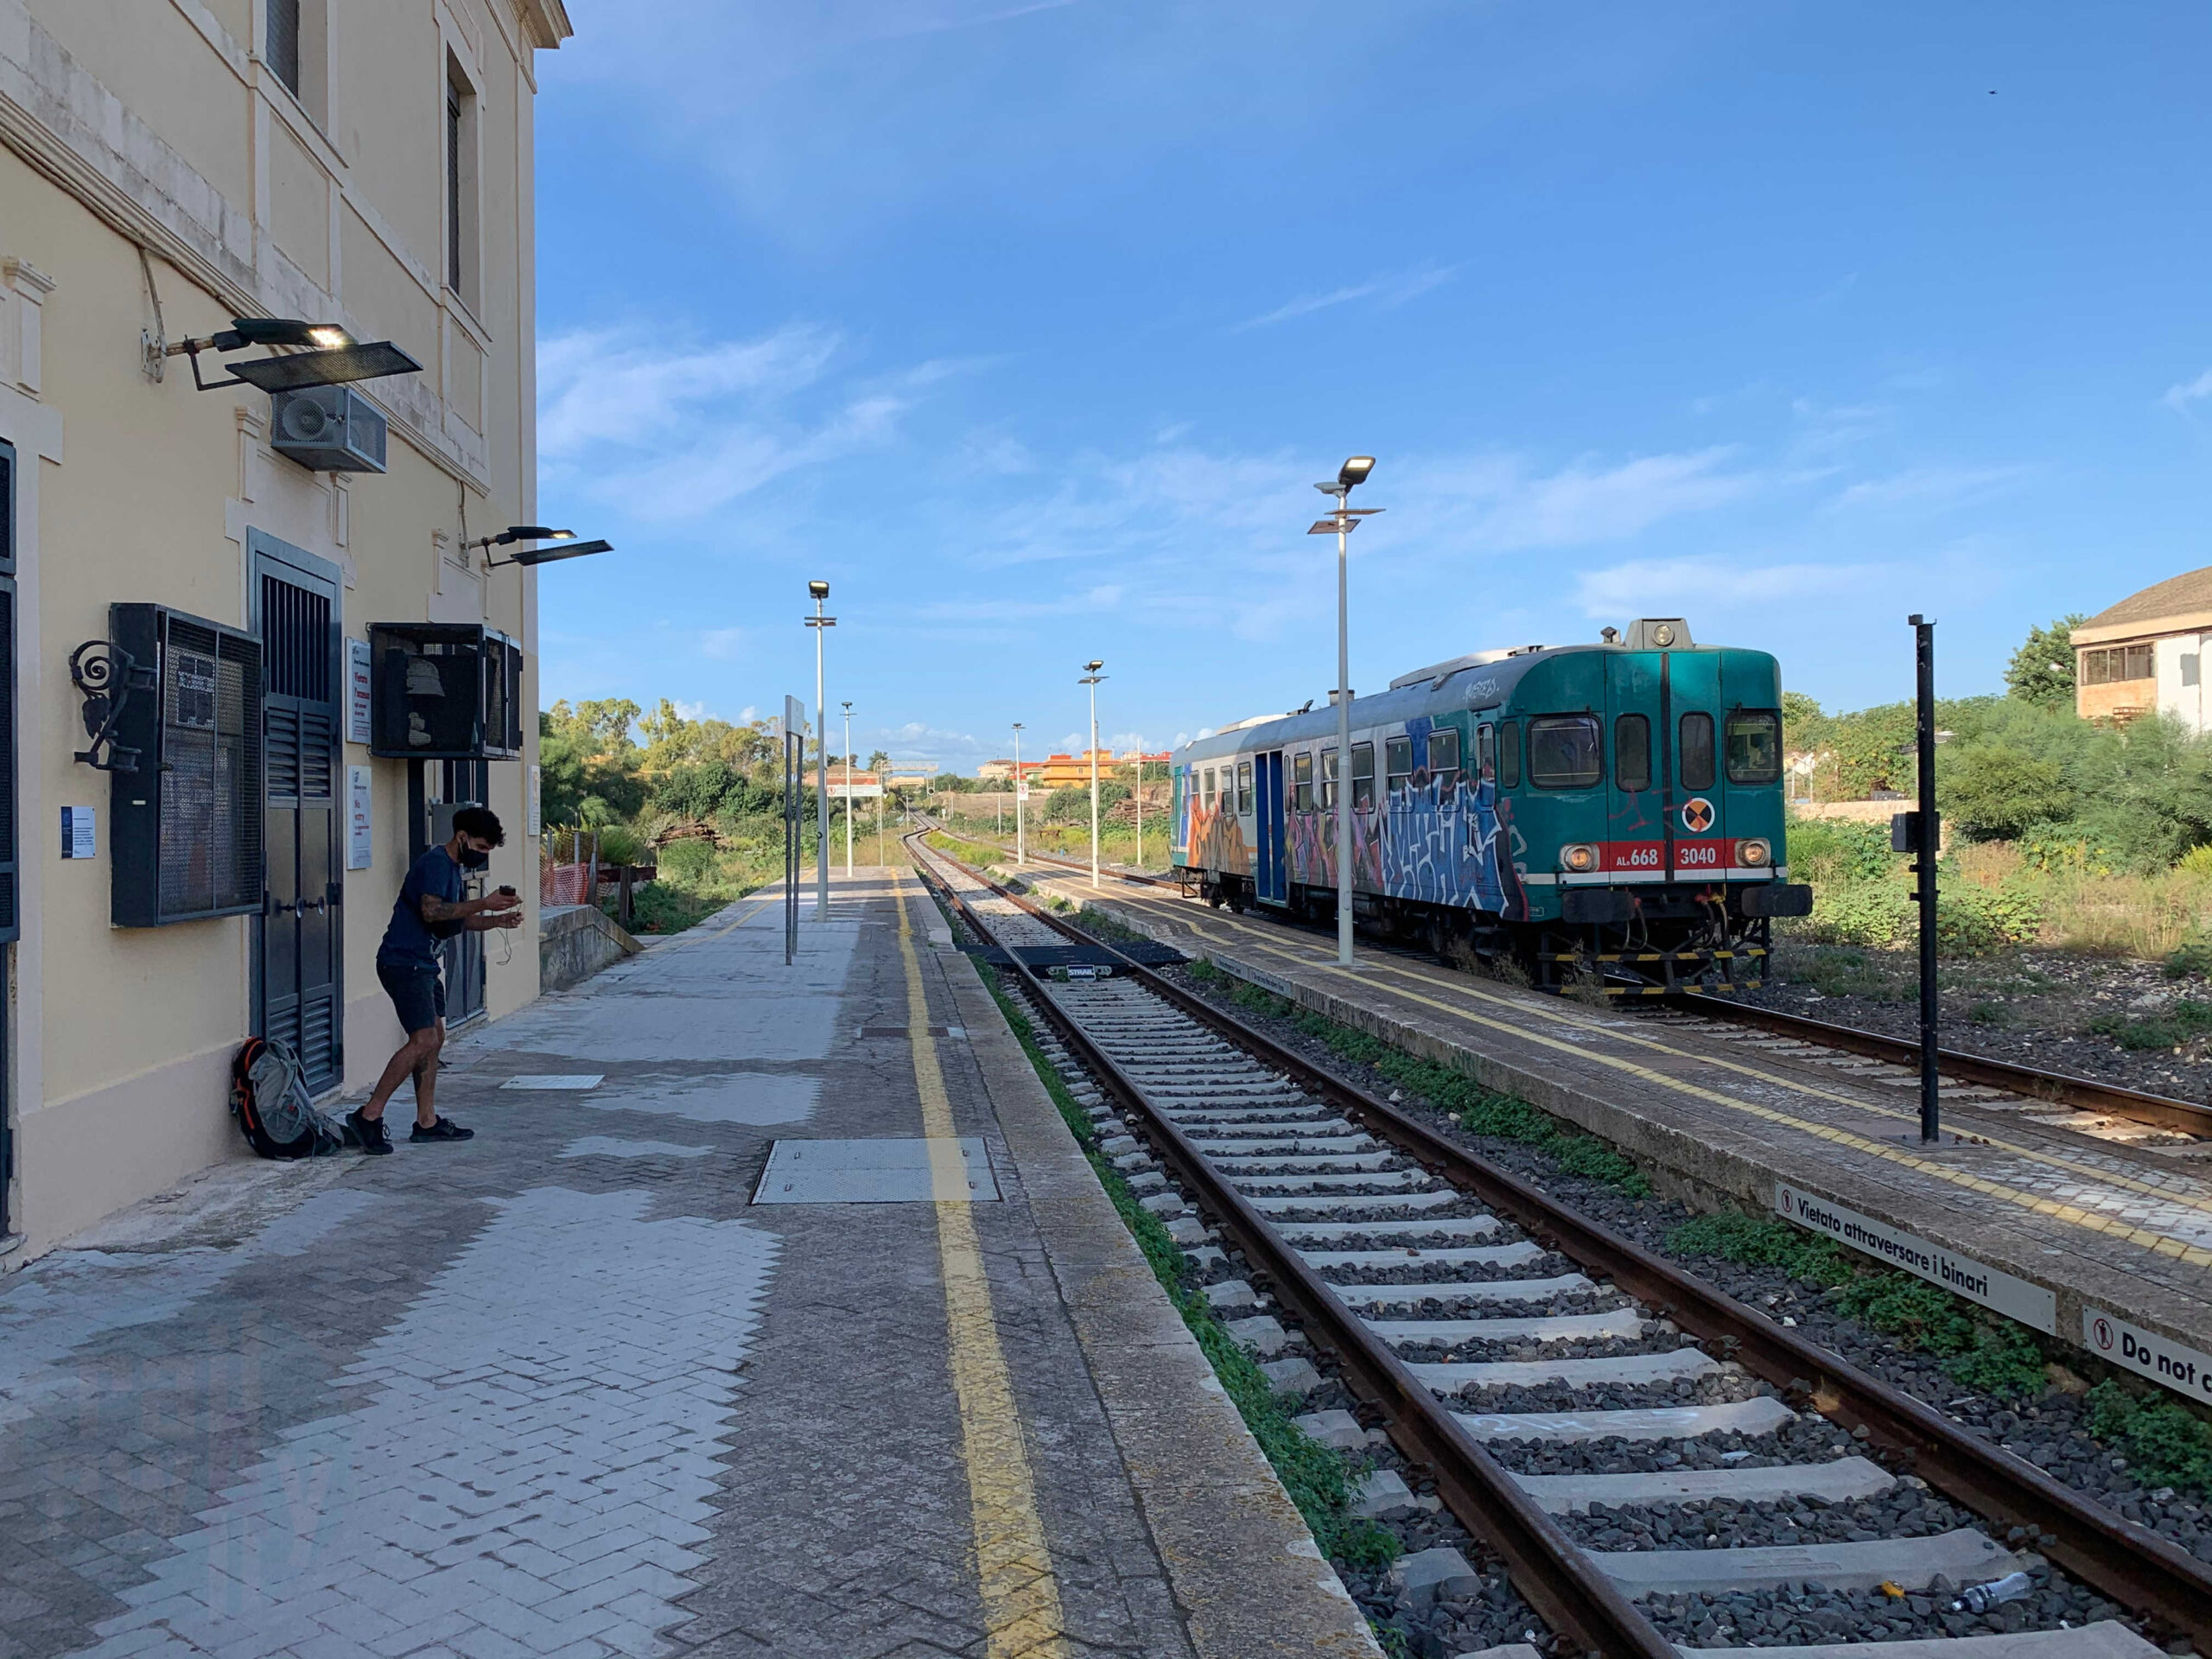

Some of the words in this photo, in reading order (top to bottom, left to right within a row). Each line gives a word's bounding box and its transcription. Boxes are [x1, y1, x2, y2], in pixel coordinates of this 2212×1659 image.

[1681, 847, 1716, 865] 3040
[1797, 1198, 1840, 1232] Vietato
[1844, 1223, 1929, 1271] attraversare
[1933, 1254, 1937, 1274] i
[1941, 1256, 1988, 1297] binari
[2122, 1332, 2152, 1365] Do
[2158, 1354, 2196, 1385] not
